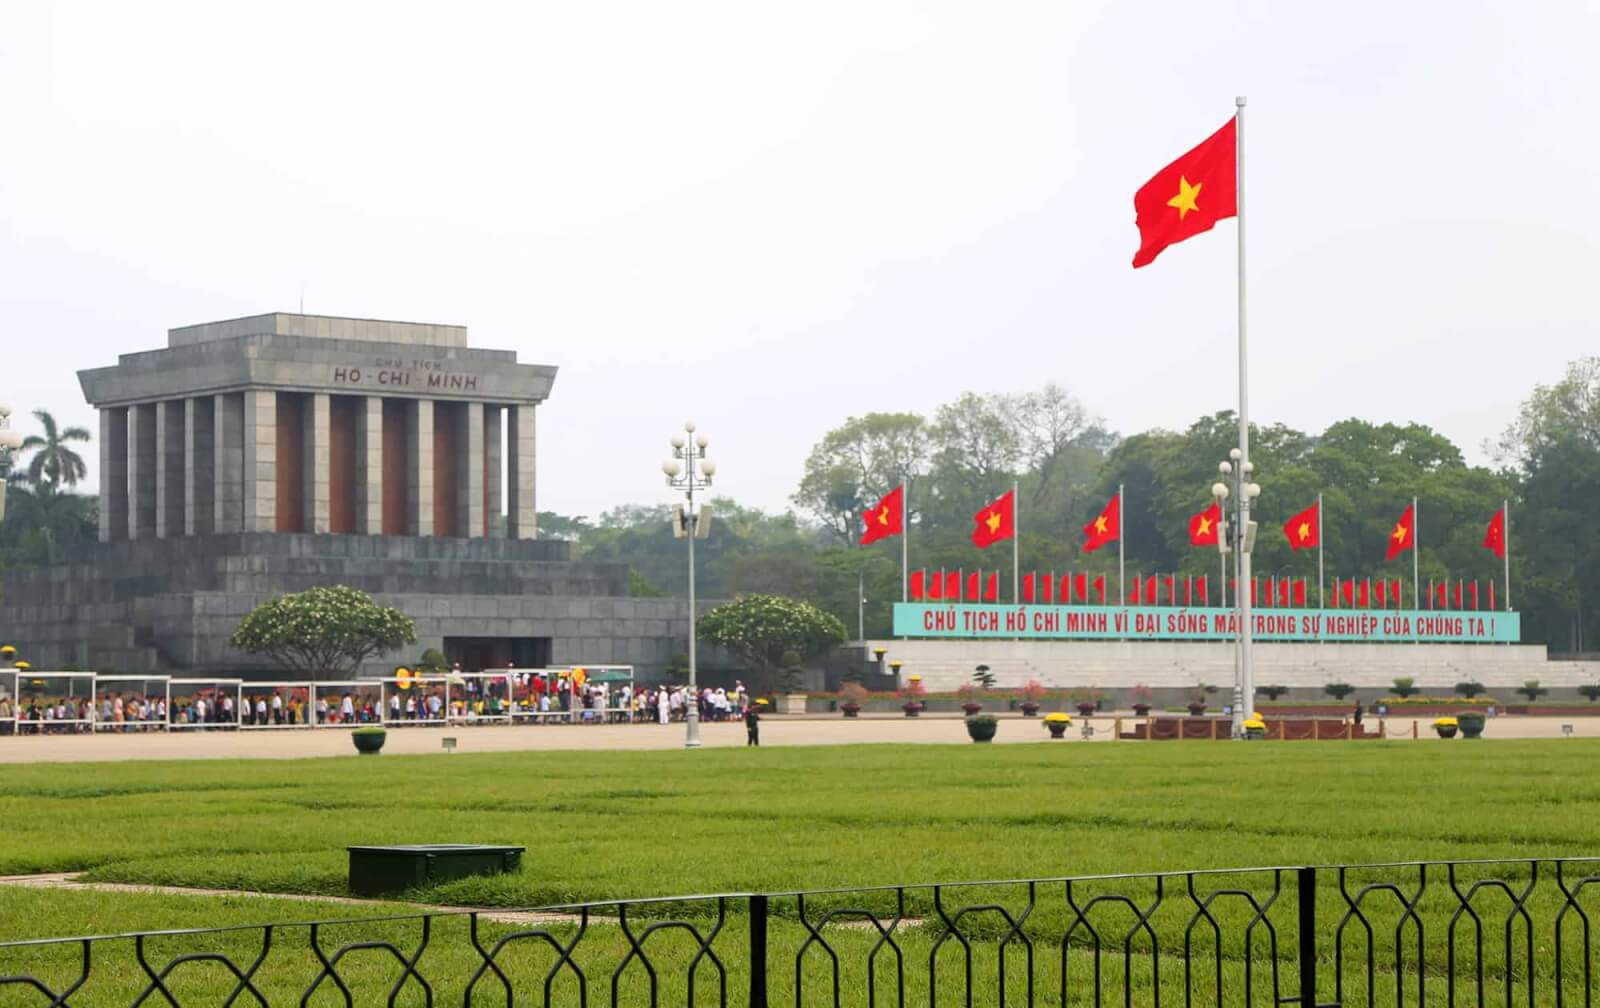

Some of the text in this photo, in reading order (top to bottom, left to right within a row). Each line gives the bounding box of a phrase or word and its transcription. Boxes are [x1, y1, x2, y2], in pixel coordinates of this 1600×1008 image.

[924, 605, 956, 631] CHỦ
[963, 611, 998, 635] TỊCH
[1034, 608, 1060, 632] CHÍ
[1067, 612, 1107, 632] MINH
[1135, 613, 1161, 637] ĐẠI
[1167, 609, 1207, 633] SỐNG
[1302, 613, 1322, 639] SỰ
[1326, 612, 1377, 638] NGHIỆP
[1383, 611, 1410, 635] CỦA
[1416, 613, 1462, 636] CHÚNG
[1468, 617, 1485, 636] TA
